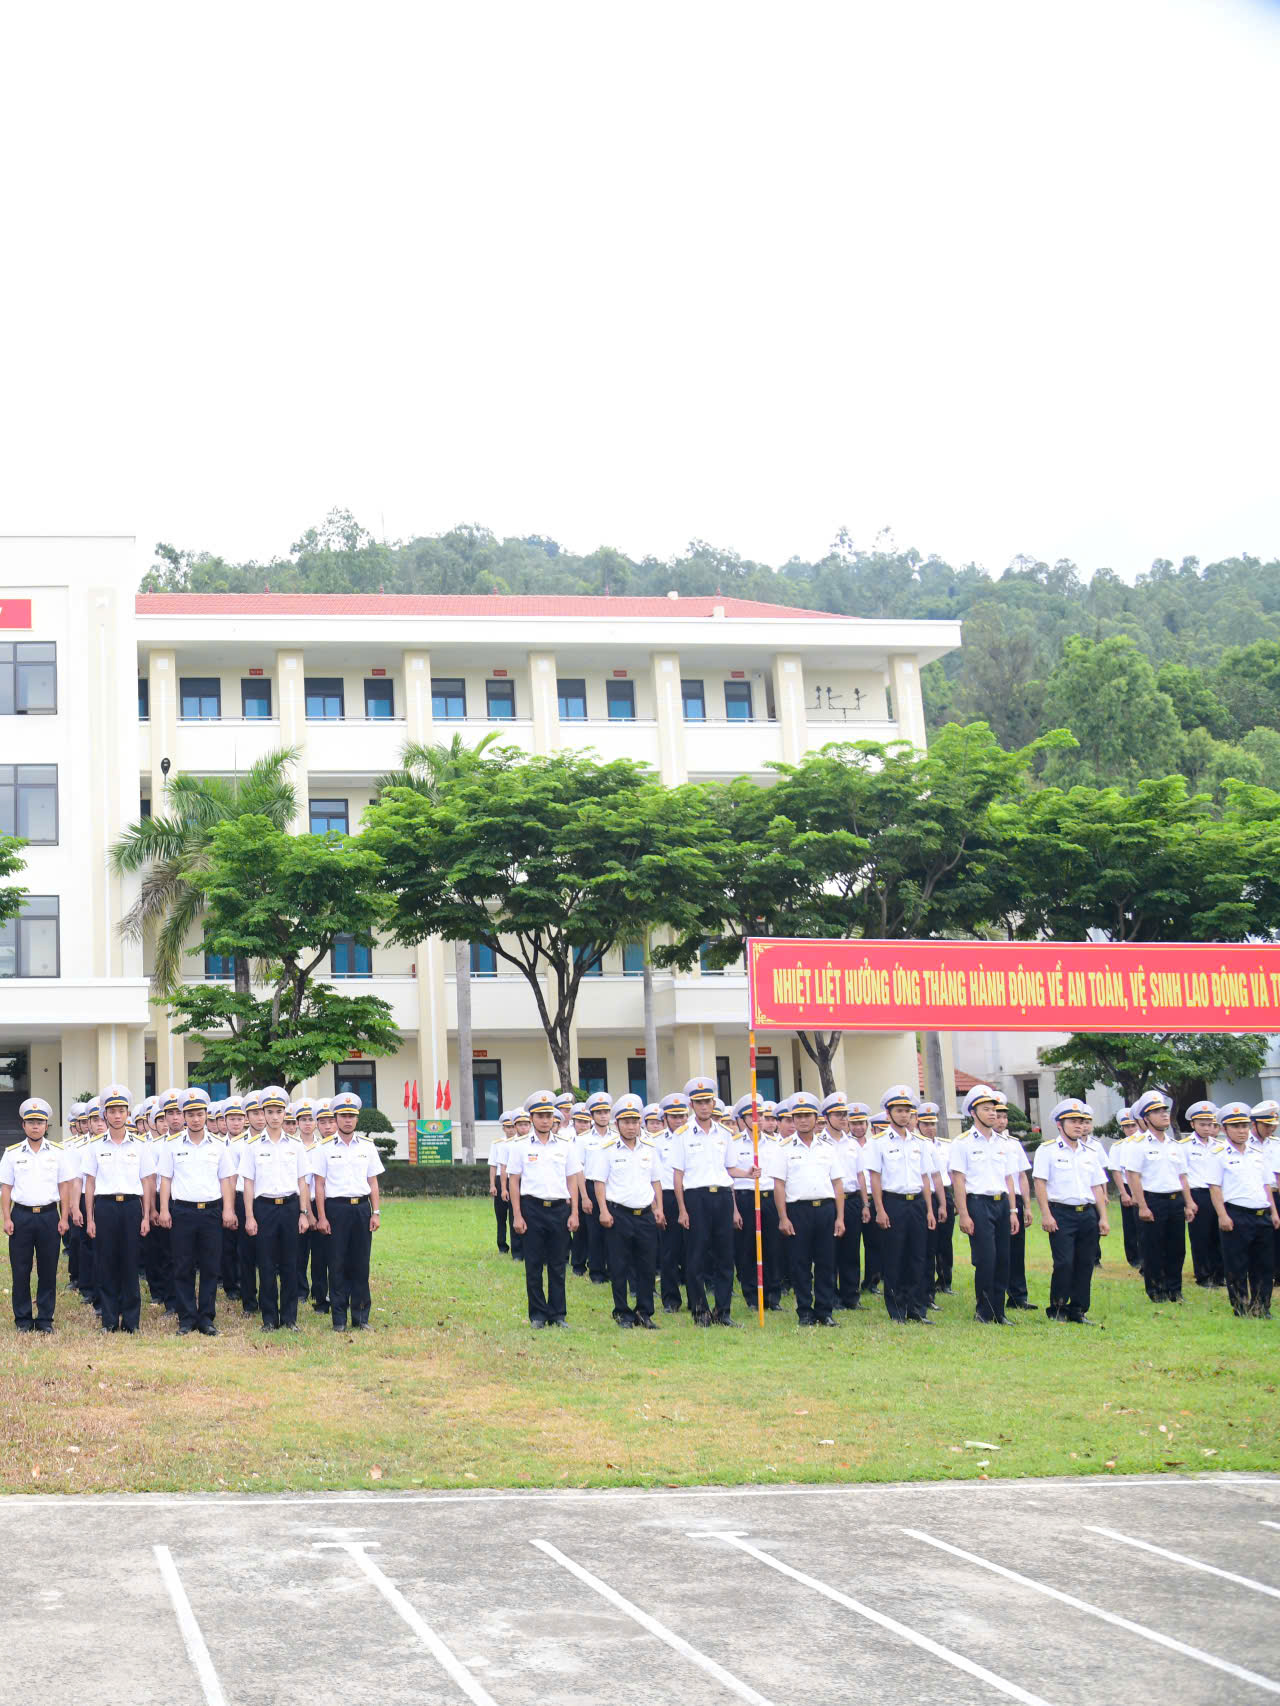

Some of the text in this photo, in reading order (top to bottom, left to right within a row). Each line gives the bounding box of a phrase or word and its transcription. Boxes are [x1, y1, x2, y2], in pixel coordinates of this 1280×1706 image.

[773, 957, 1280, 1015] NHIỆT LIỆT HƯỞNG ỨNG THÁNG HÀNH ĐỘNG VỀ AN TOÀN, VỆ SINH LAO ĐỘNG VÀ T
